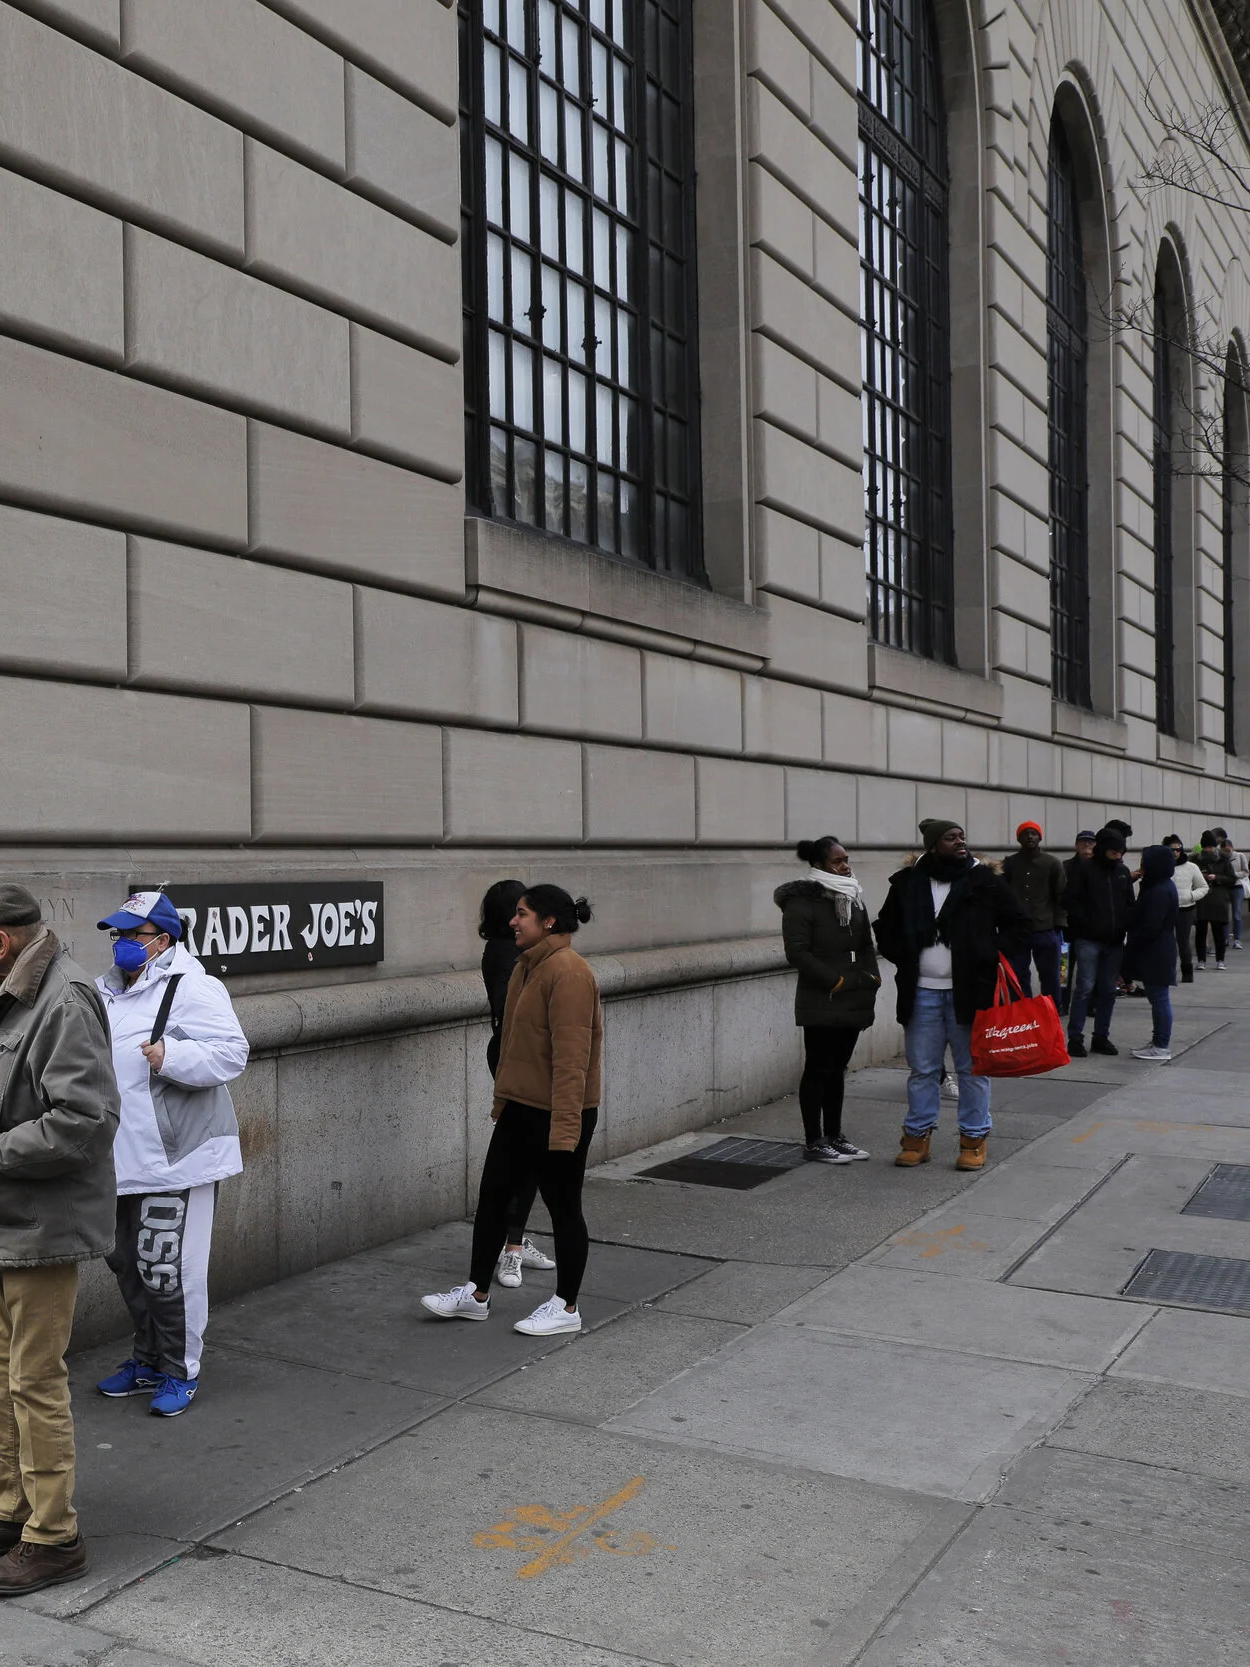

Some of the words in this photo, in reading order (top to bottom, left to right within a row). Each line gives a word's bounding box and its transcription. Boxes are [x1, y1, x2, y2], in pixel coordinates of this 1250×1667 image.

[175, 904, 293, 957] RADER
[300, 899, 378, 949] JOE'S
[985, 1020, 1040, 1040] Walgreens
[136, 1190, 187, 1292] OSS
